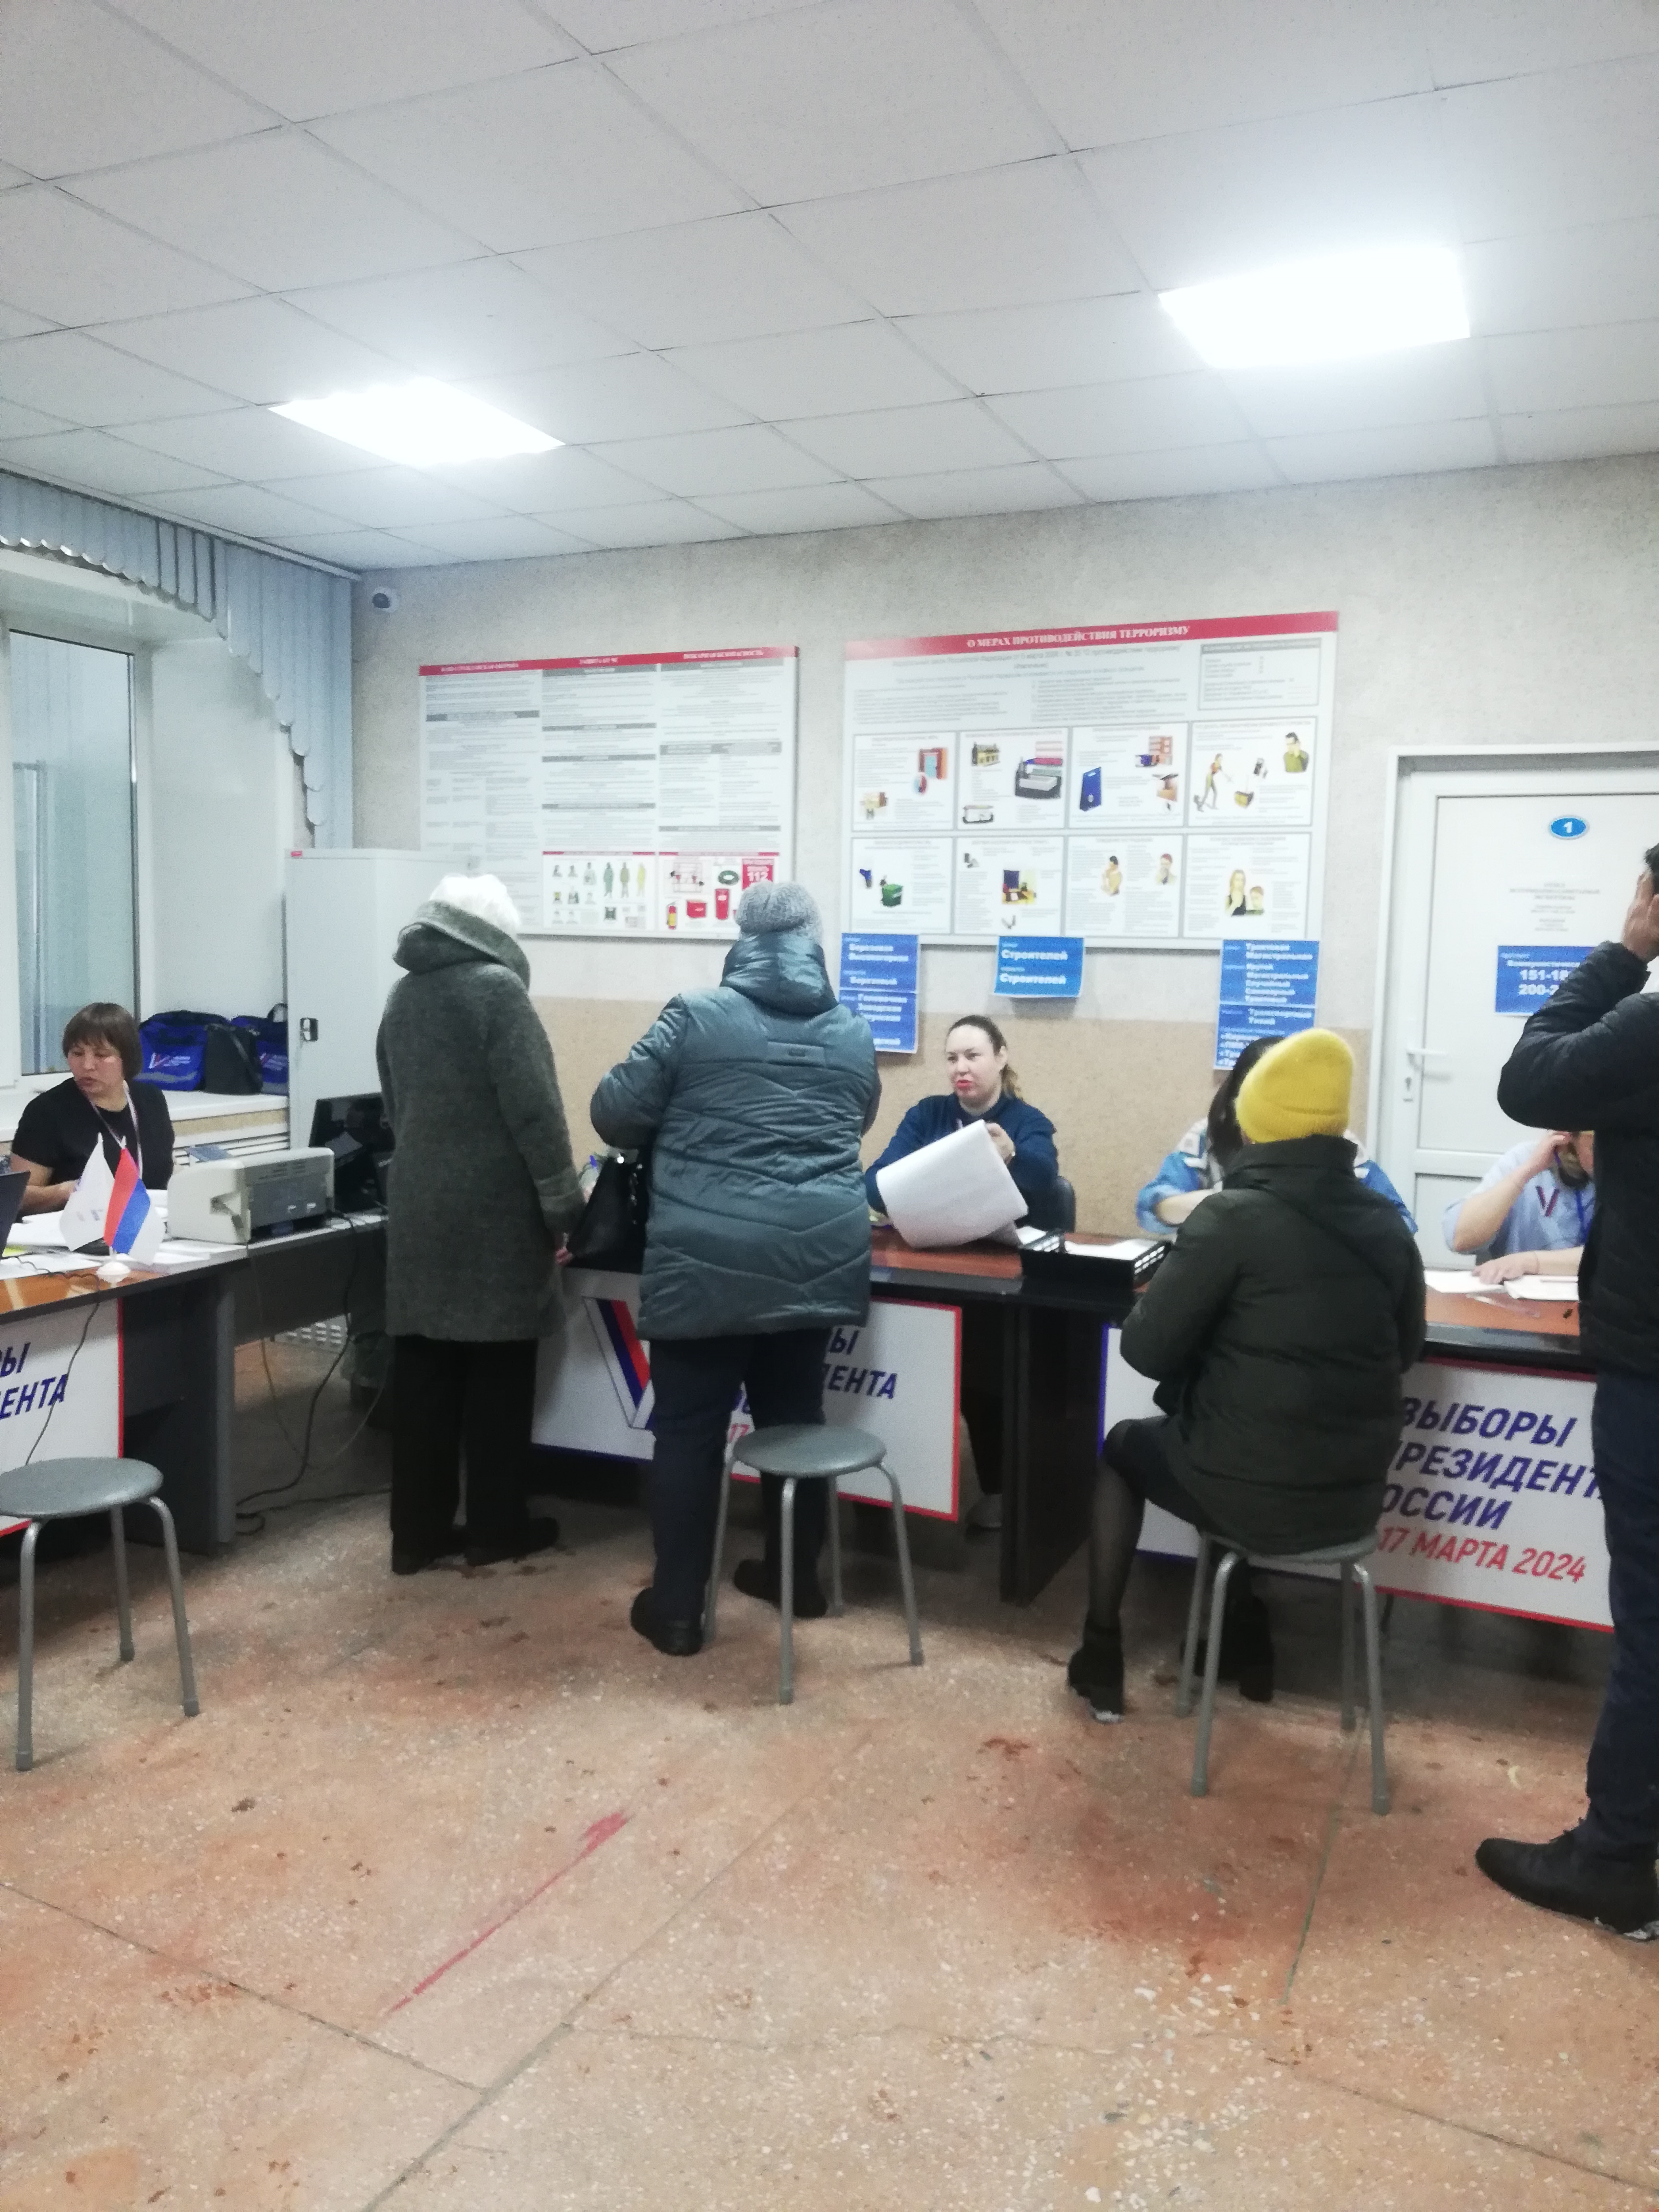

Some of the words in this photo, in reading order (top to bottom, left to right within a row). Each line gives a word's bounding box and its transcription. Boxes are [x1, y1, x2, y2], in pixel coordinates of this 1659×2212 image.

[977, 637, 1010, 647] МЕРАХ
[1013, 630, 1117, 645] ПРОТИВОДЕЙСТВИЯ
[1119, 625, 1189, 638] ТЕРРОРИЗМУ
[1563, 821, 1572, 833] 1
[0, 1374, 67, 1419] ЕНТА
[1402, 1396, 1578, 1447] ВЫБОРЫ
[1395, 1442, 1601, 1499] РЕЗИДЕНТ
[1383, 1484, 1513, 1530] ОССИИ
[1410, 1532, 1510, 1571] МАРТА
[1513, 1548, 1586, 1583] 2024
